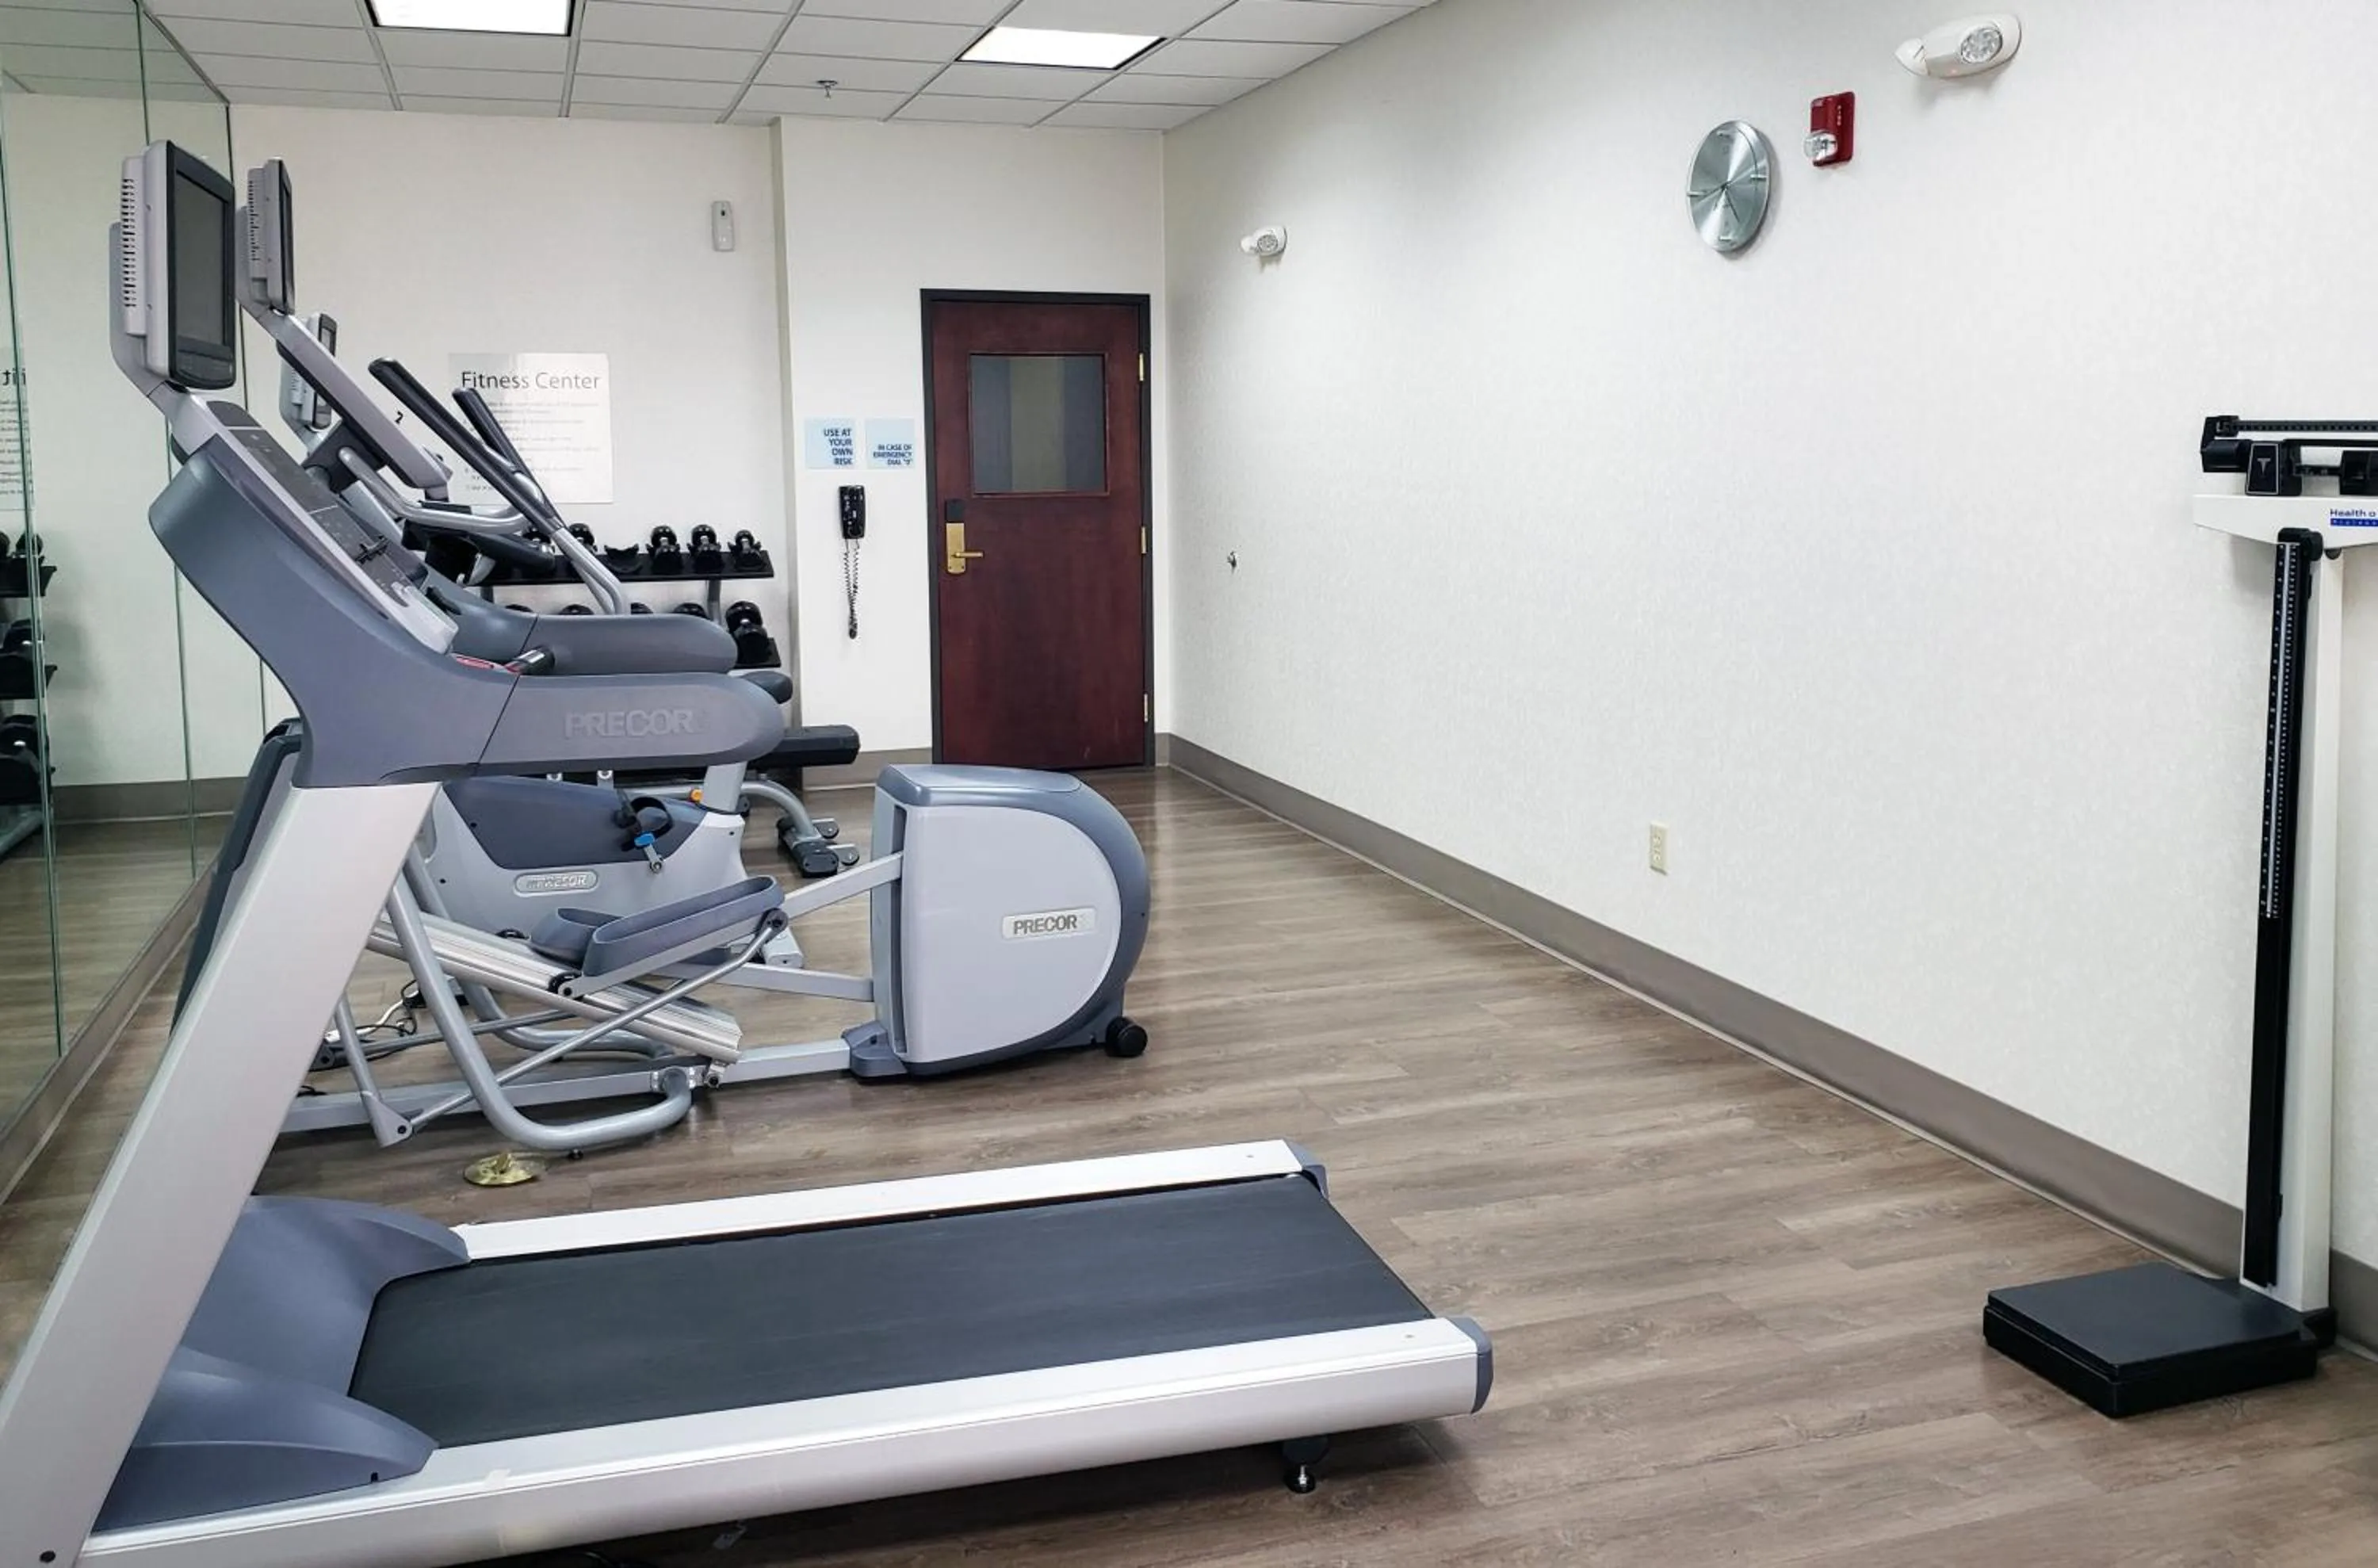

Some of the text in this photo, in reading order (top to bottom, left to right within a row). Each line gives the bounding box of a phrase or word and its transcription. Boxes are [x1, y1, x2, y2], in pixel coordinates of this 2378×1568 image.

[461, 371, 600, 389] Fitness Center
[824, 428, 852, 437] USE AT
[2330, 508, 2366, 518] Health
[563, 709, 694, 739] PRECOR
[1013, 914, 1078, 935] PRECOR
